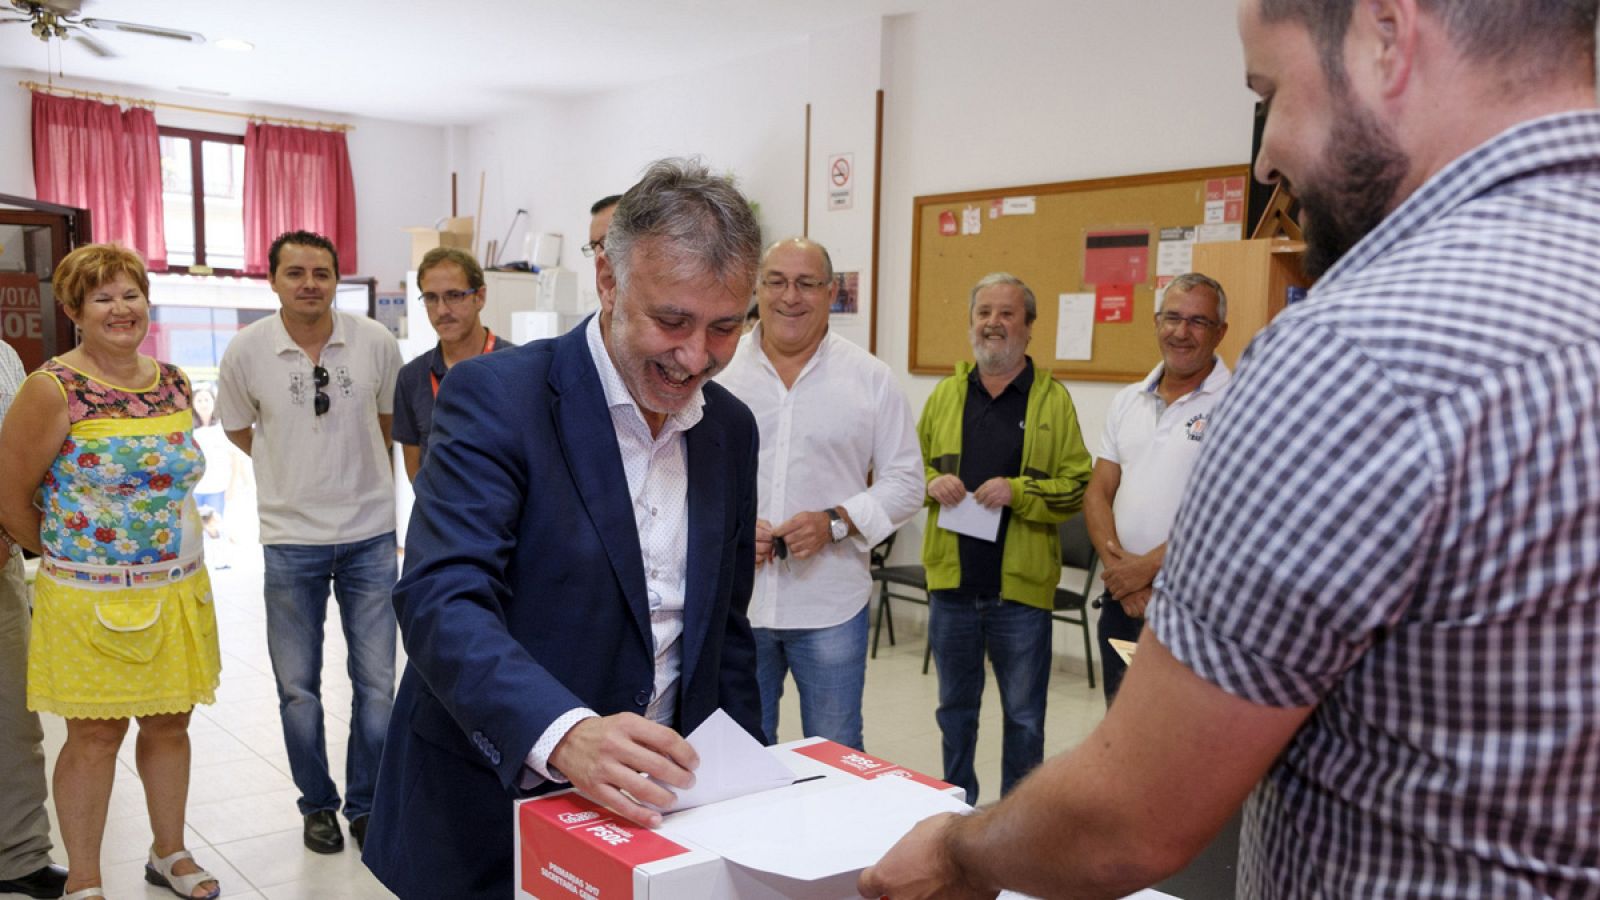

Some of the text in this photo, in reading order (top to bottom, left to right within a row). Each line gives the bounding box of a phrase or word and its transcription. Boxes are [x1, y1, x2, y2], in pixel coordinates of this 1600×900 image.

[0, 312, 43, 339] OE
[585, 825, 630, 846] PSOE
[541, 867, 578, 895] SECRETARIA
[548, 862, 600, 897] PRIMARIAS 2017
